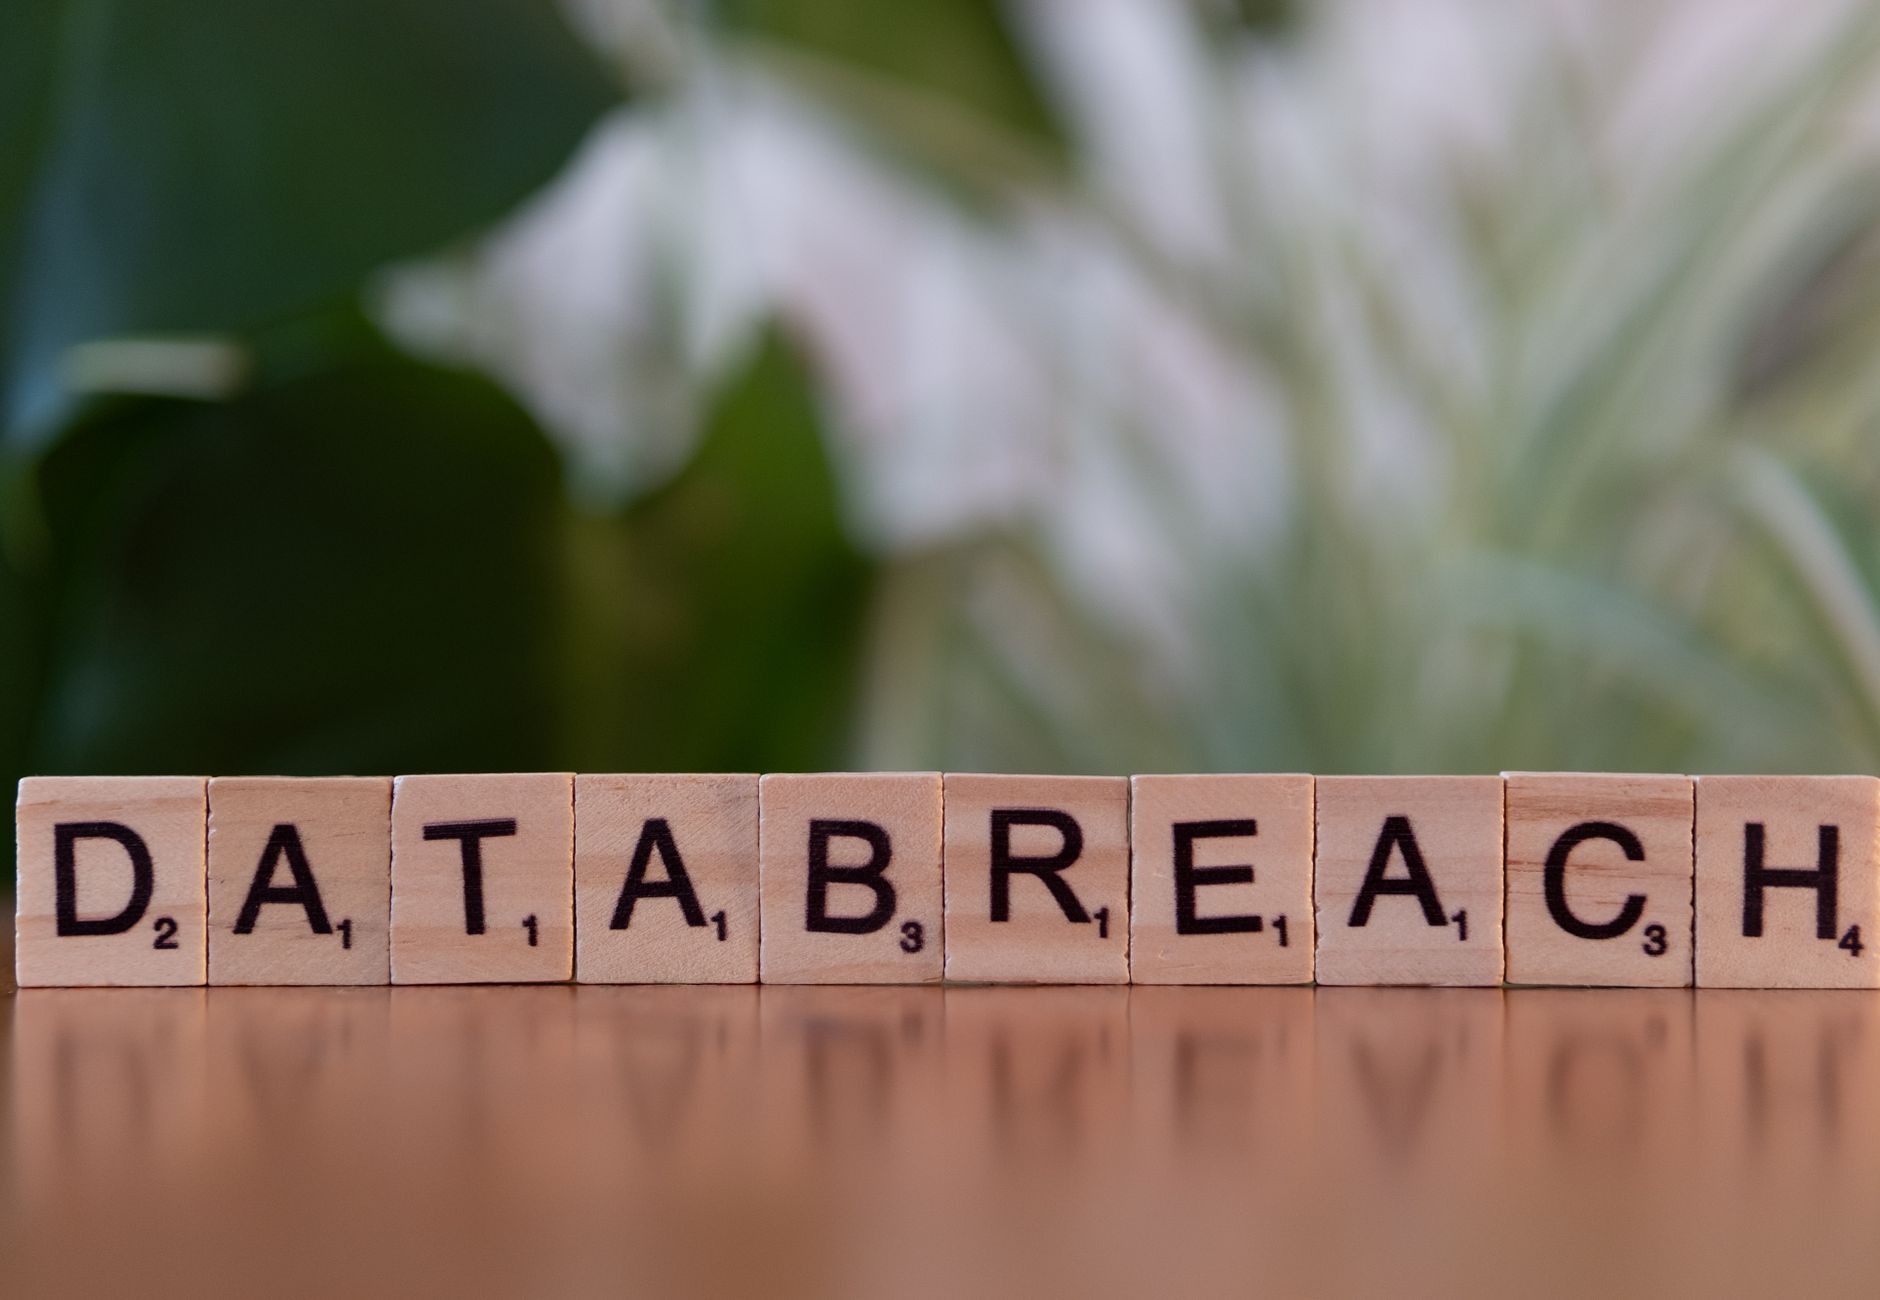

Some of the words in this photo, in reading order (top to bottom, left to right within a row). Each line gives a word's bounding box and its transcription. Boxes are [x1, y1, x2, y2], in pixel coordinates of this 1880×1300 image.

[152, 916, 179, 950] 2
[335, 918, 353, 950] 1
[521, 913, 539, 948] 1
[709, 910, 728, 942] 1
[899, 920, 926, 955] 3
[1093, 906, 1110, 940] 1
[1271, 914, 1289, 948] 1
[1450, 909, 1468, 942] 1
[1641, 923, 1669, 958] 3
[1837, 924, 1865, 958] 4
